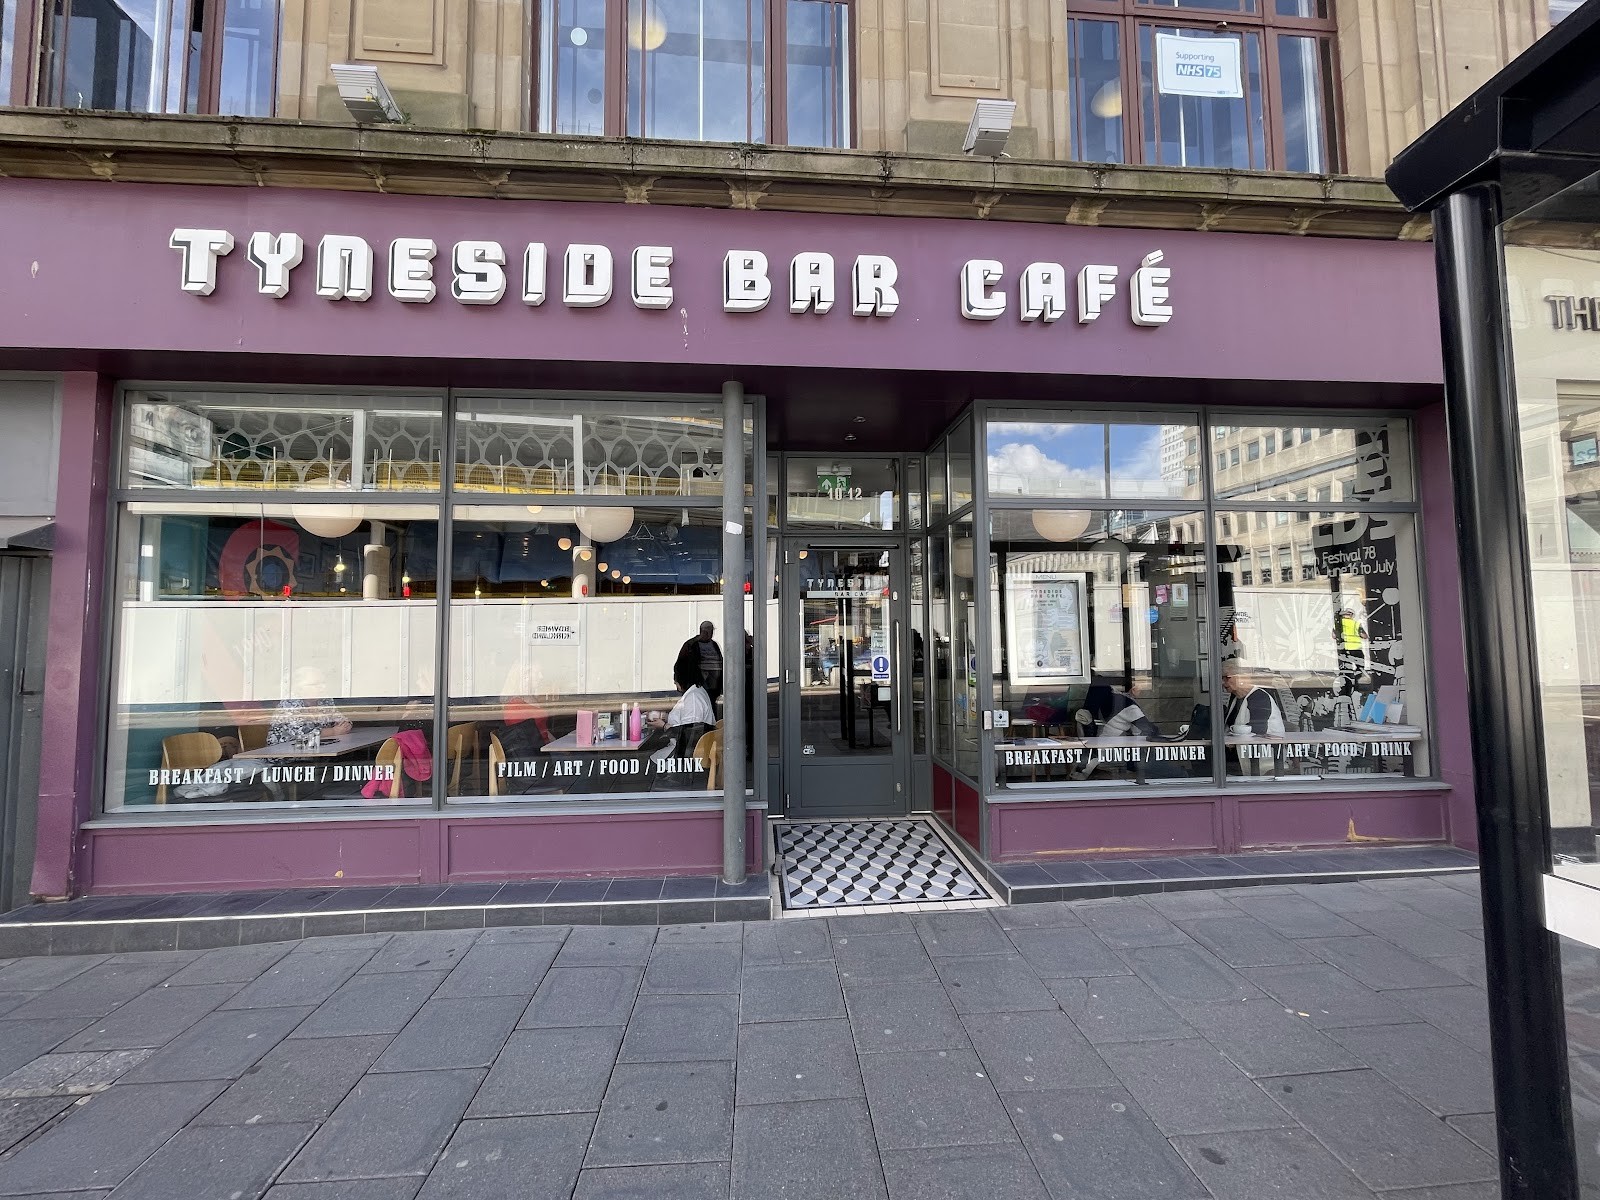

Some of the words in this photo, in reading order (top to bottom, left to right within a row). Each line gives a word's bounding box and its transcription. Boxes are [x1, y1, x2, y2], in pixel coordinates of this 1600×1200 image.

[1176, 51, 1215, 62] Supporting
[169, 227, 674, 309] TYNESIDE
[723, 249, 900, 318] BAR
[960, 248, 1174, 327] CAFÉ
[1322, 547, 1362, 564] Festival
[1362, 545, 1376, 560] 78
[1360, 561, 1372, 575] to
[1373, 558, 1395, 576] July
[1005, 749, 1083, 766] BREAKFAST
[1097, 747, 1141, 763] LUNCH
[1155, 745, 1206, 761] DINNER
[1240, 744, 1272, 759] FILM
[1286, 743, 1311, 758] ART
[1324, 742, 1358, 757] FOOD
[1371, 741, 1413, 756] DRINK
[148, 767, 244, 786] BREAKFAST
[261, 765, 316, 783] LUNCH
[332, 764, 395, 782] DINNER
[497, 761, 537, 778] FILM
[552, 760, 583, 777] ART
[599, 759, 640, 775] FOOD
[656, 757, 704, 774] DRINK
